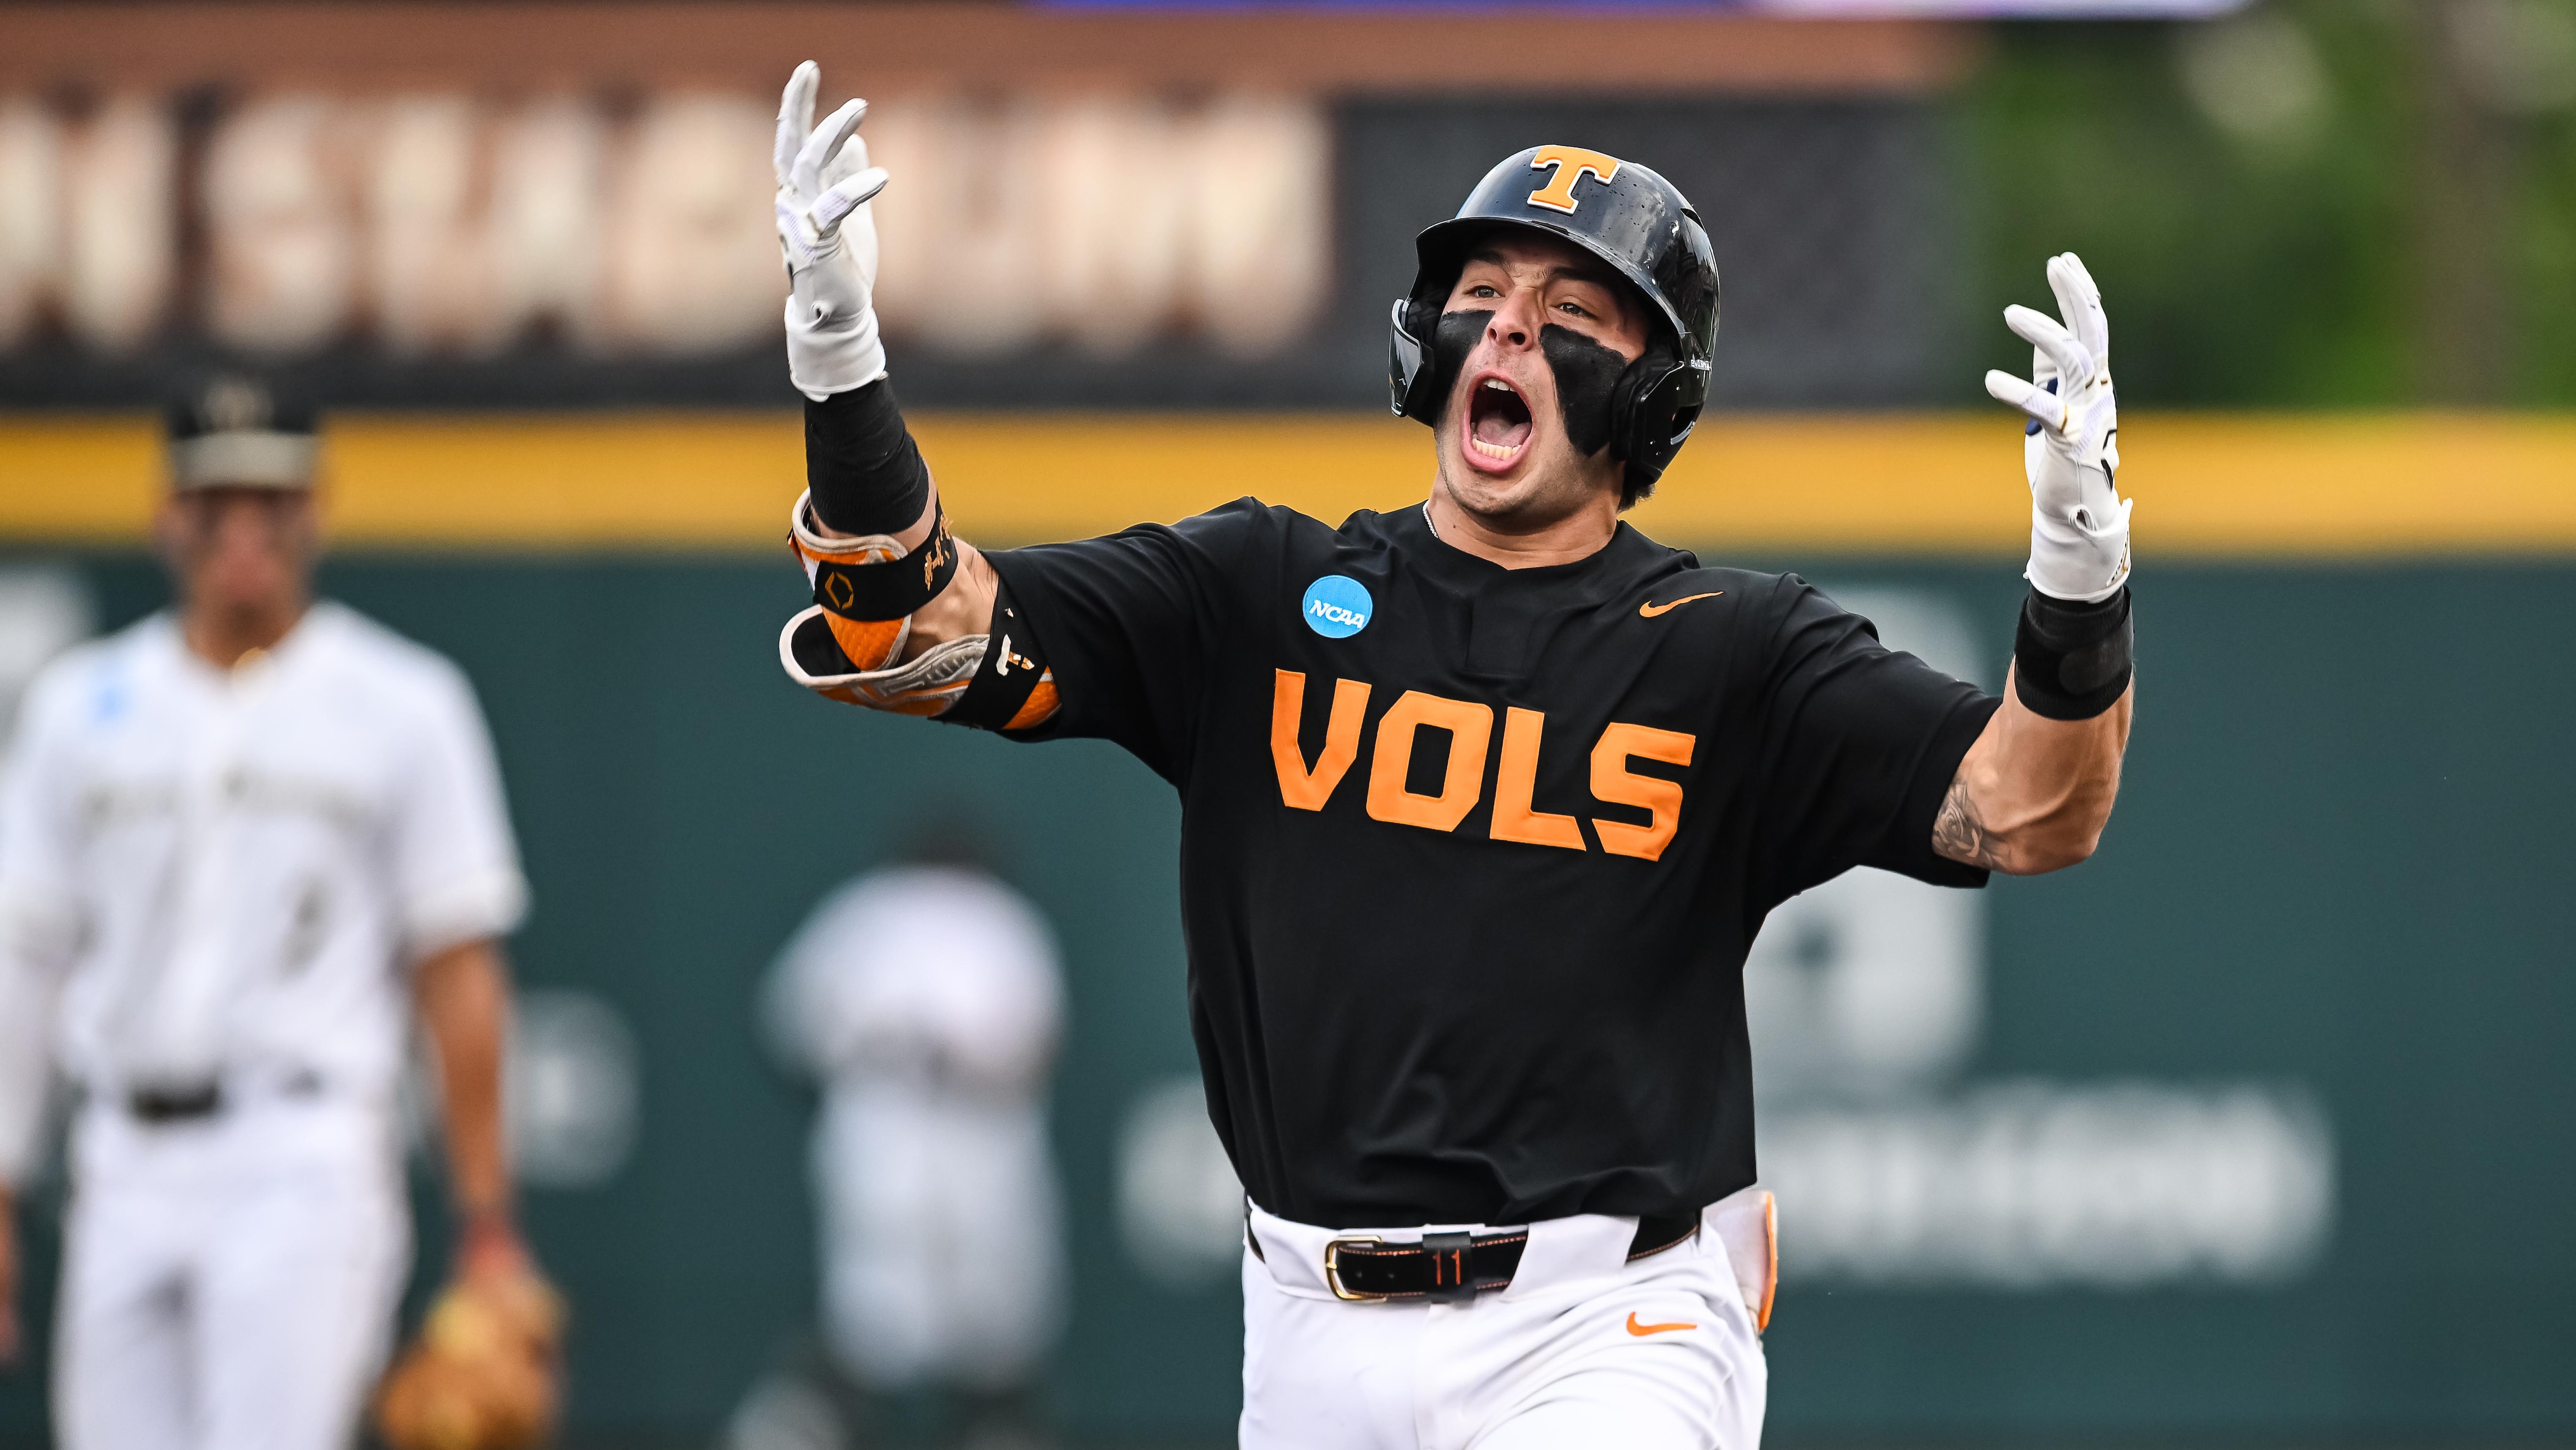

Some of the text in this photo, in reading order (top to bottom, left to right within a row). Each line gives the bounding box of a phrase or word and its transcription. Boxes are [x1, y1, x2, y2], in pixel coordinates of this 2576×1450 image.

[1527, 145, 1621, 215] T
[1309, 599, 1365, 629] NCAA
[1271, 669, 1696, 862] VOLS
[1432, 1249, 1461, 1285] 11
